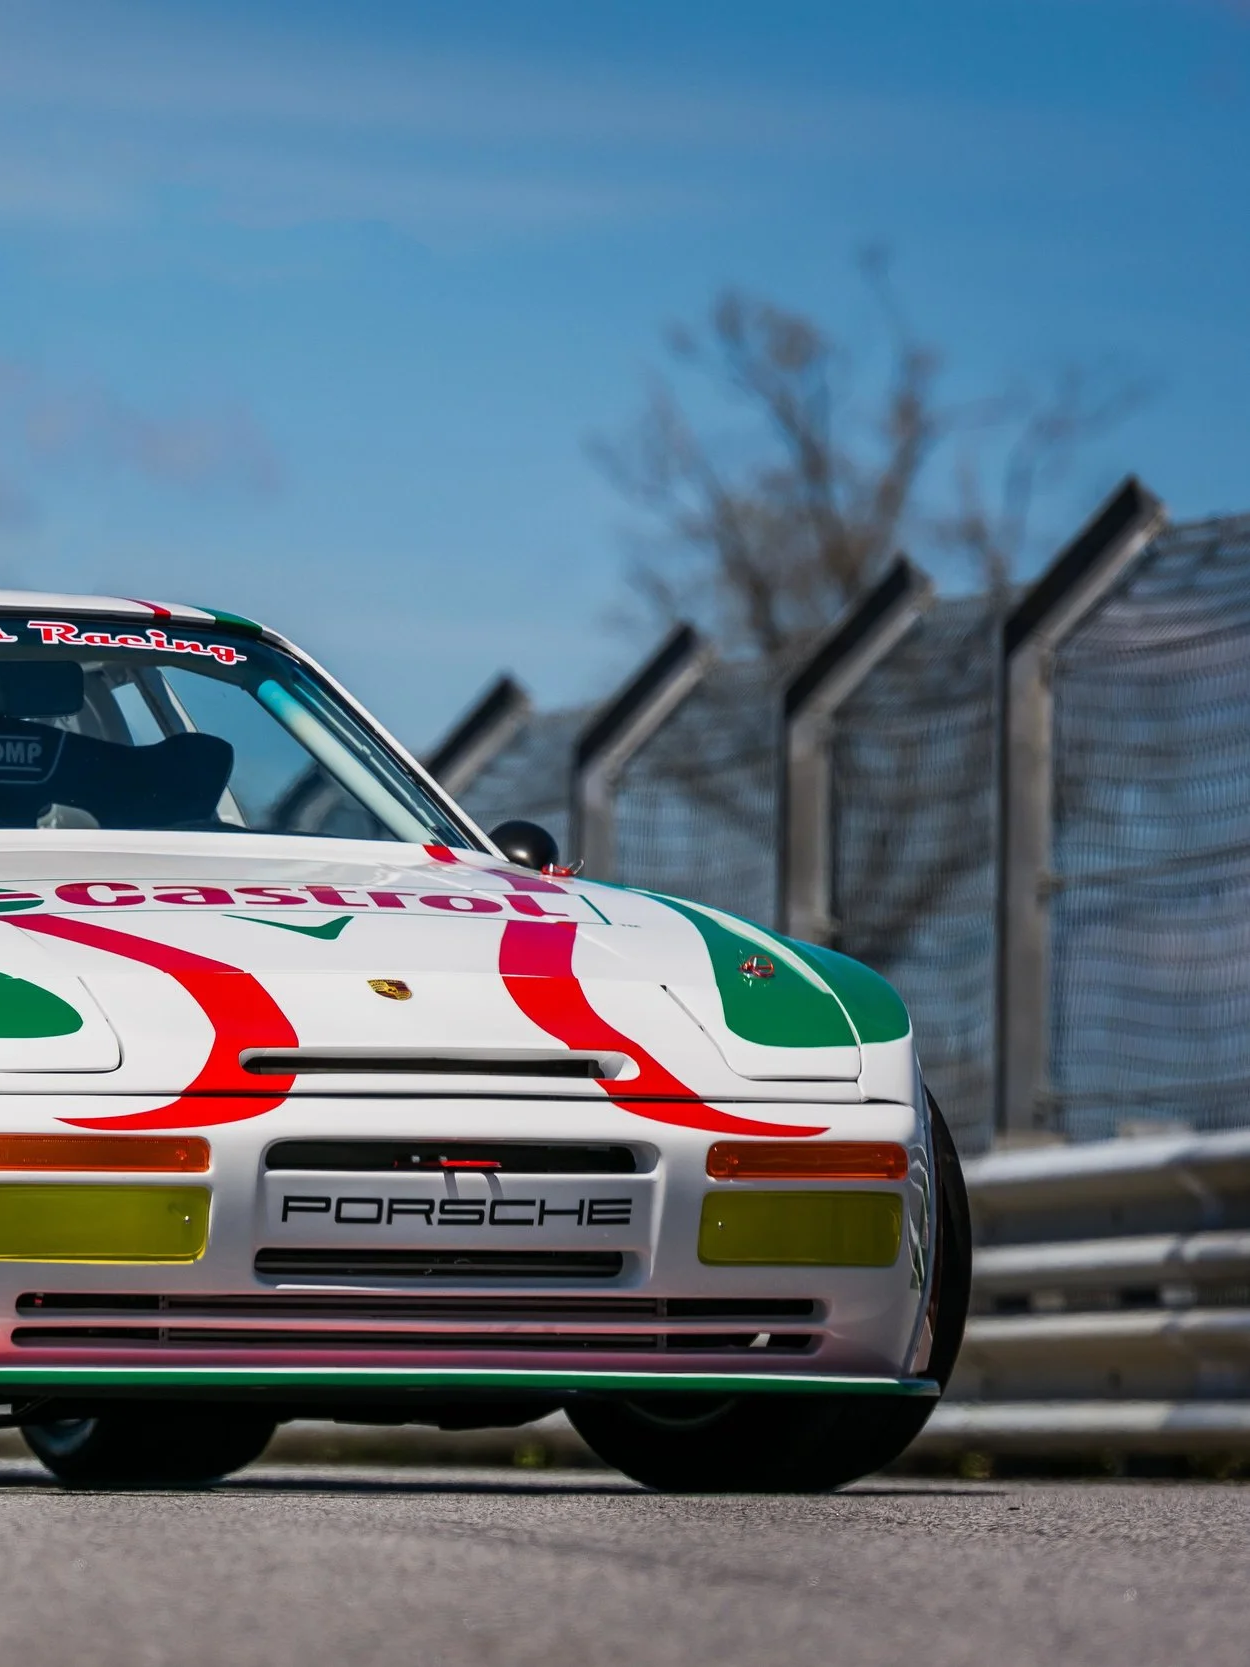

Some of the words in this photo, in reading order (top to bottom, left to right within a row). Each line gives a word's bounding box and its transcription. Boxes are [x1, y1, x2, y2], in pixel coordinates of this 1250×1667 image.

[29, 621, 248, 664] Racing
[54, 882, 570, 917] Castrol
[281, 1195, 633, 1227] PORSCHE
